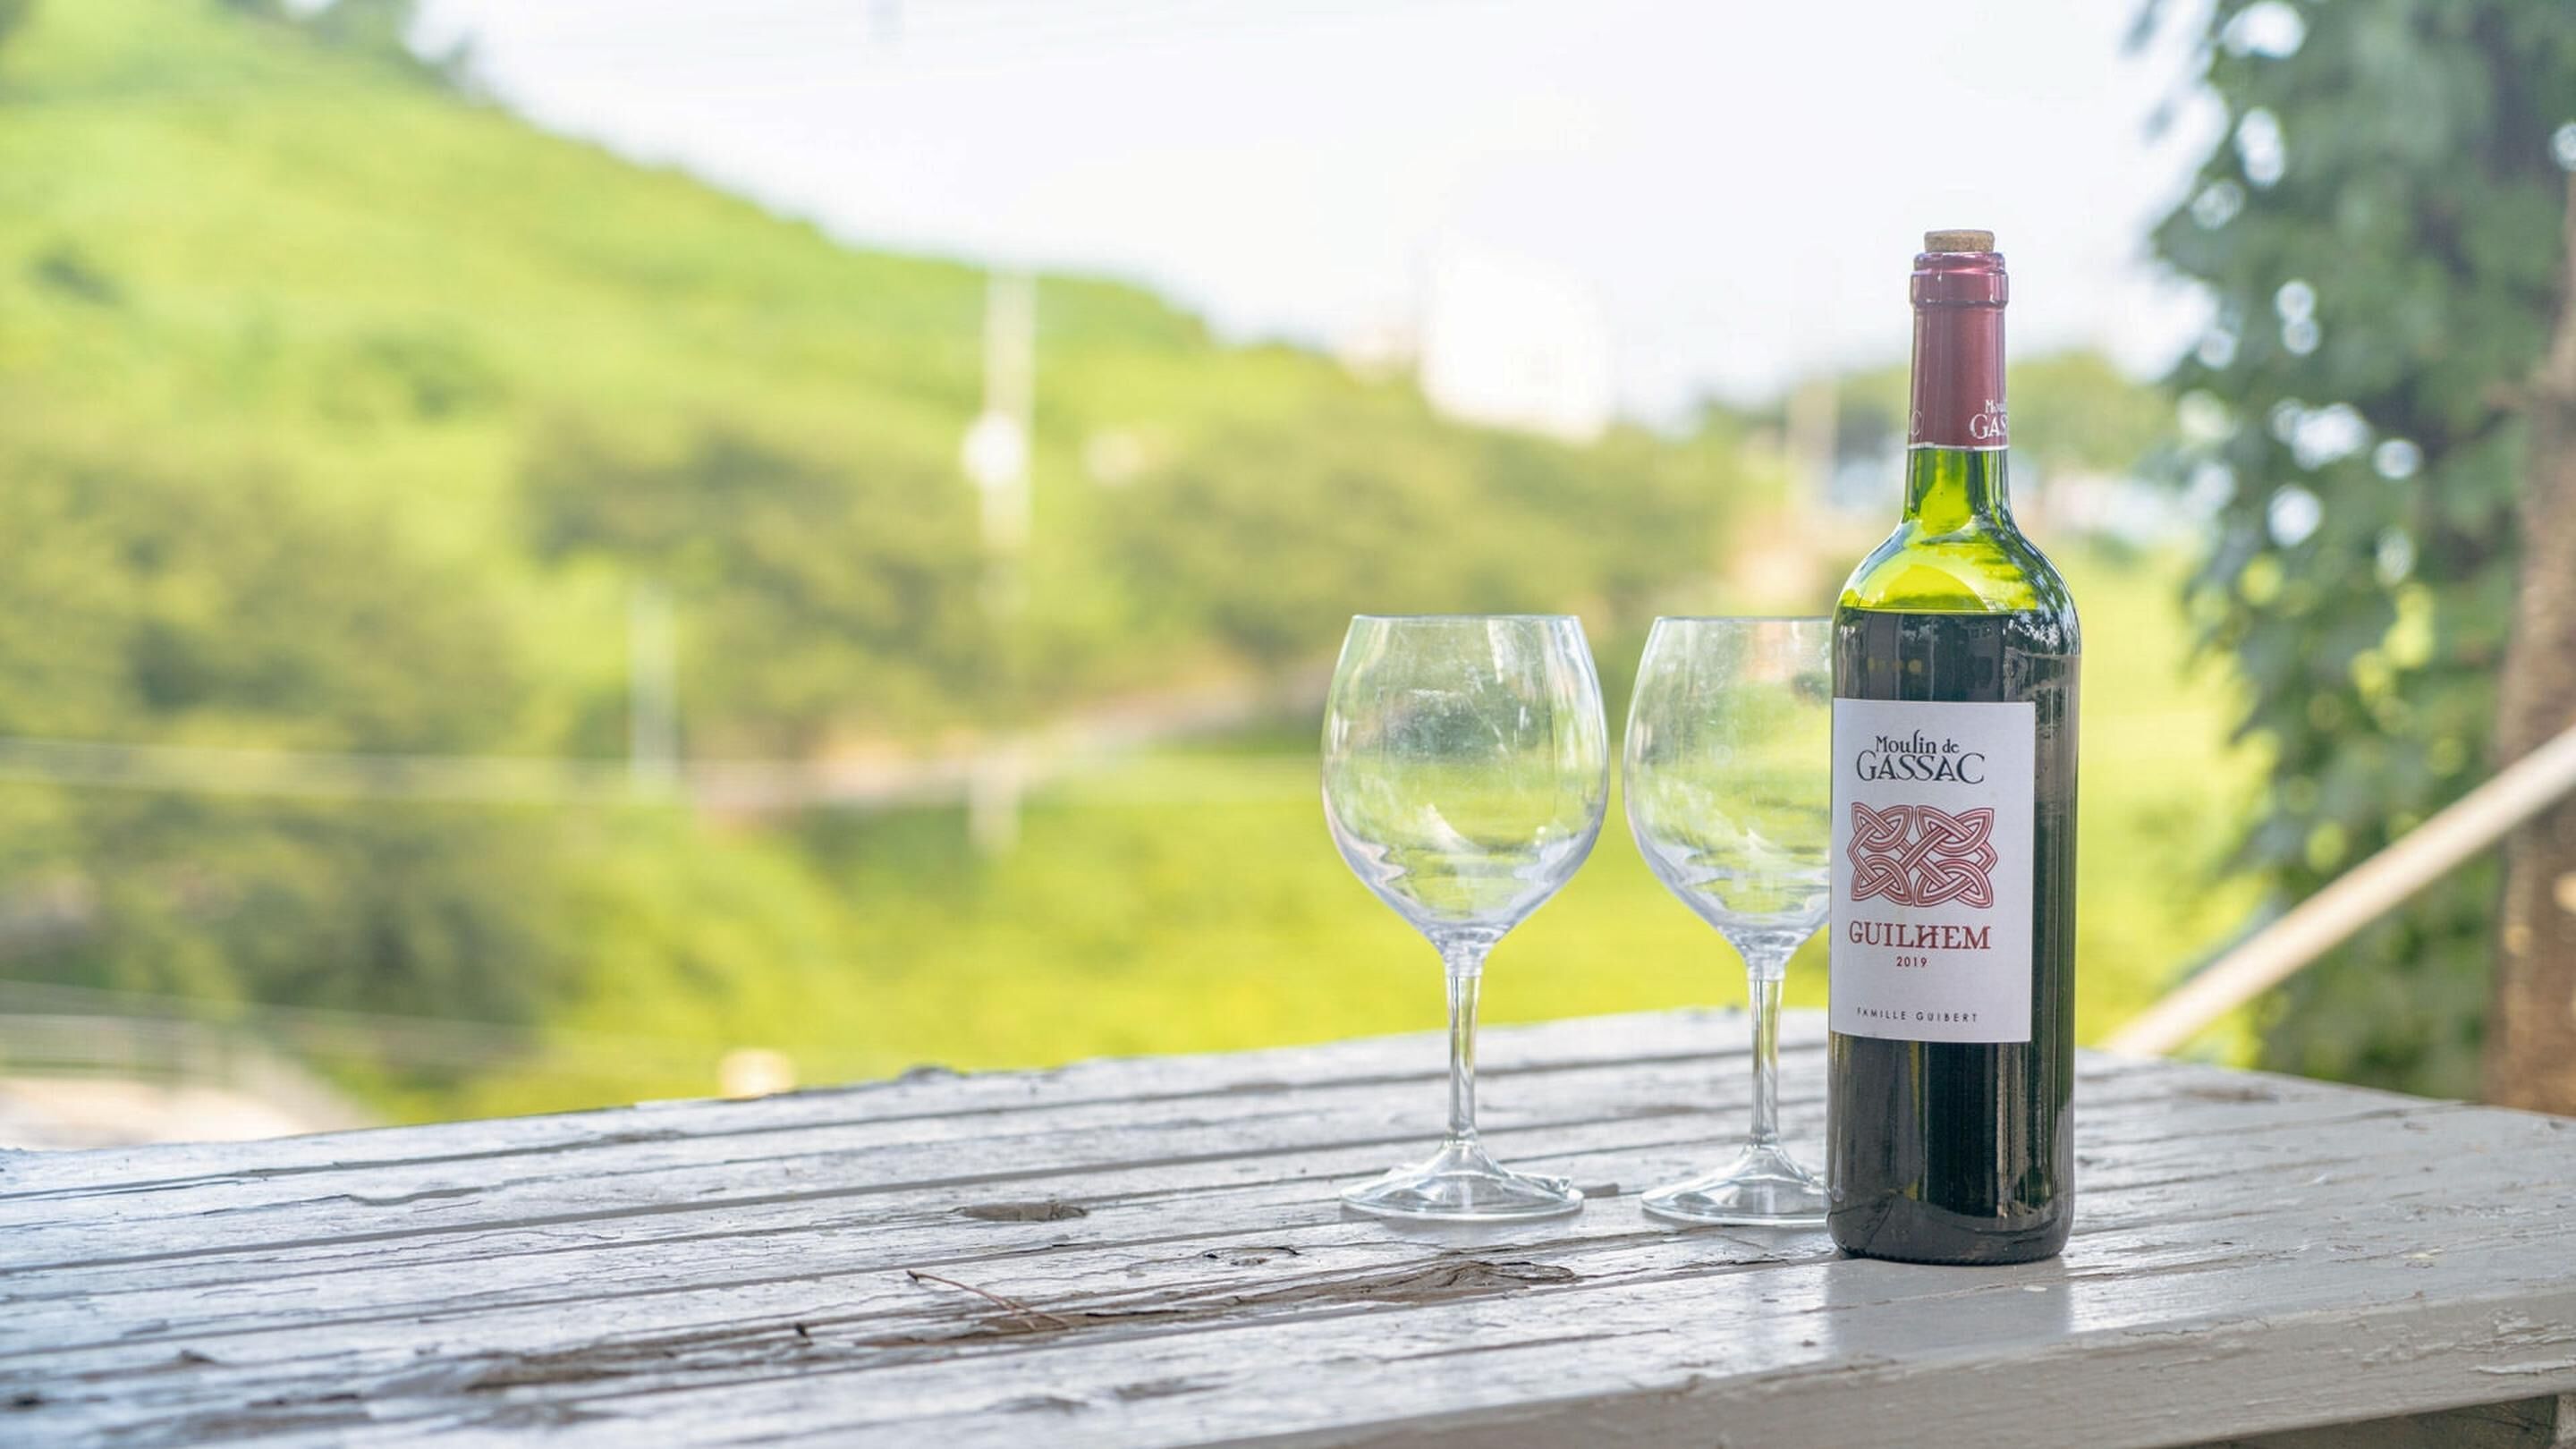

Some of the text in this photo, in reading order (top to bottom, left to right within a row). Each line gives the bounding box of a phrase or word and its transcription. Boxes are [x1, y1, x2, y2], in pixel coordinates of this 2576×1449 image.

[1876, 729, 1960, 754] Moulin de
[1856, 750, 1985, 784] GASSAC
[1849, 920, 1991, 950] GUILHEM
[1896, 956, 1928, 968] 2019
[1857, 1007, 1978, 1022] FAMILLE GUIBERT
